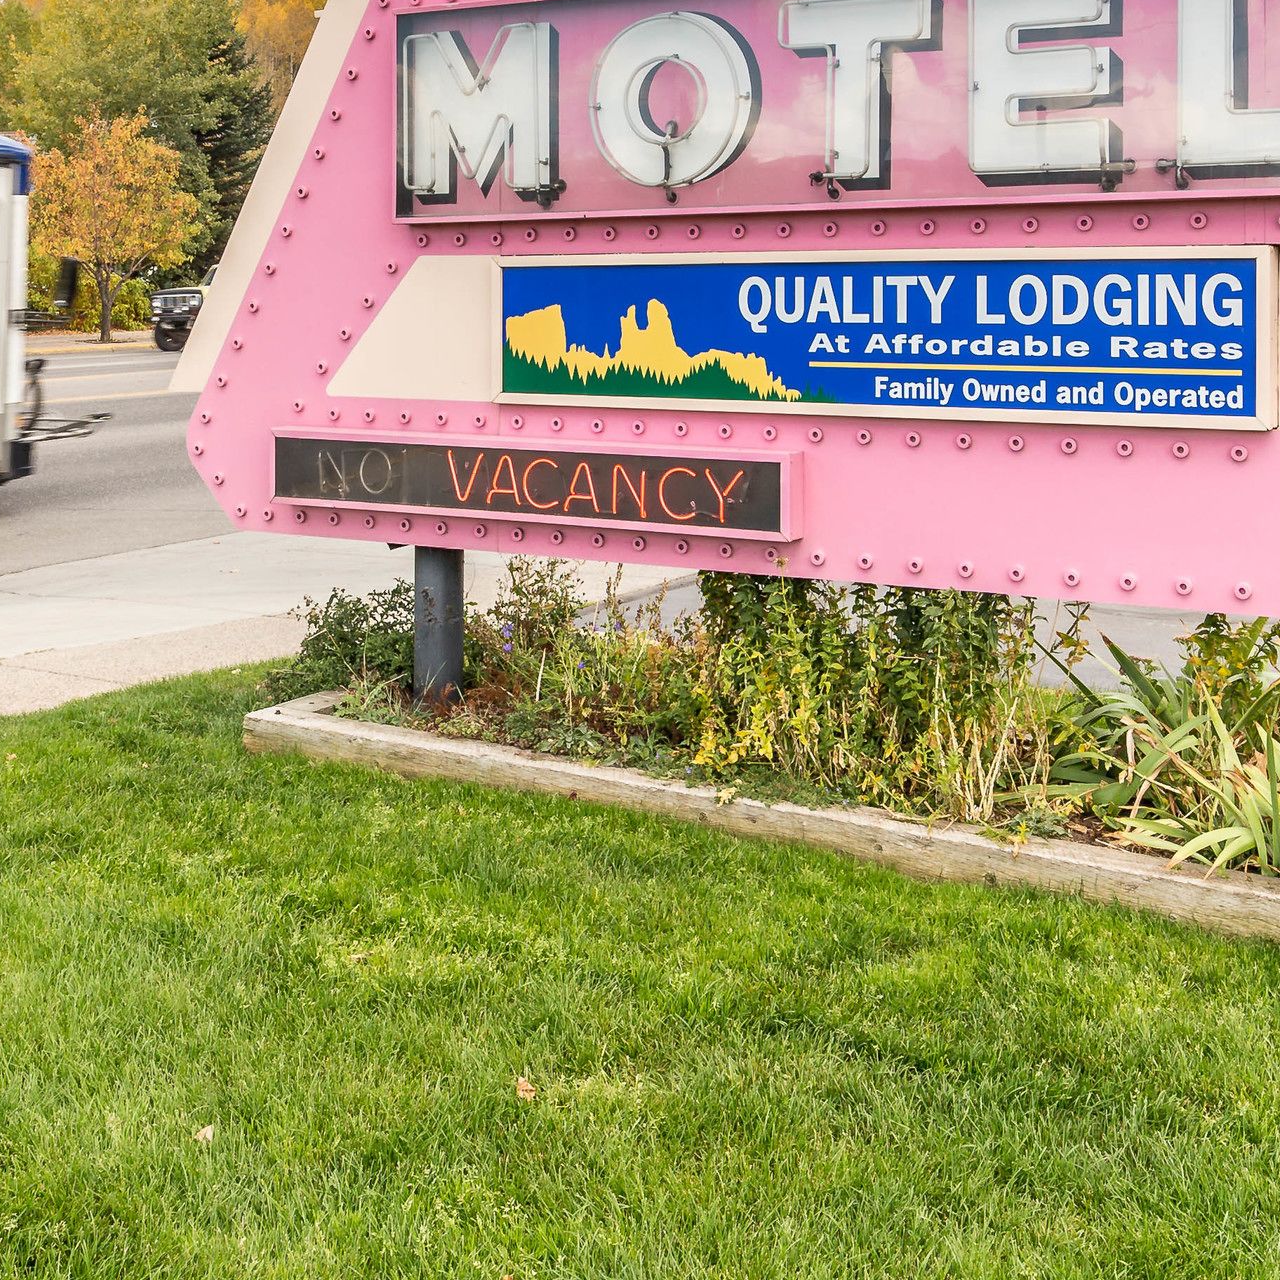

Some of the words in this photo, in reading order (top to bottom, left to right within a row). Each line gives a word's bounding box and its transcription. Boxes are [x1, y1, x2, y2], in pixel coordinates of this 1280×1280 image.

[738, 275, 956, 334] QUALITY
[976, 273, 1243, 327] LODGING
[808, 332, 850, 354] At
[864, 333, 1090, 358] Affordable
[1110, 336, 1243, 360] Rates
[875, 376, 954, 406] Family
[962, 377, 1046, 403] Owned
[1056, 381, 1104, 405] and
[1114, 381, 1244, 411] Operated
[318, 447, 393, 497] NO
[447, 450, 744, 523] VACANCY
